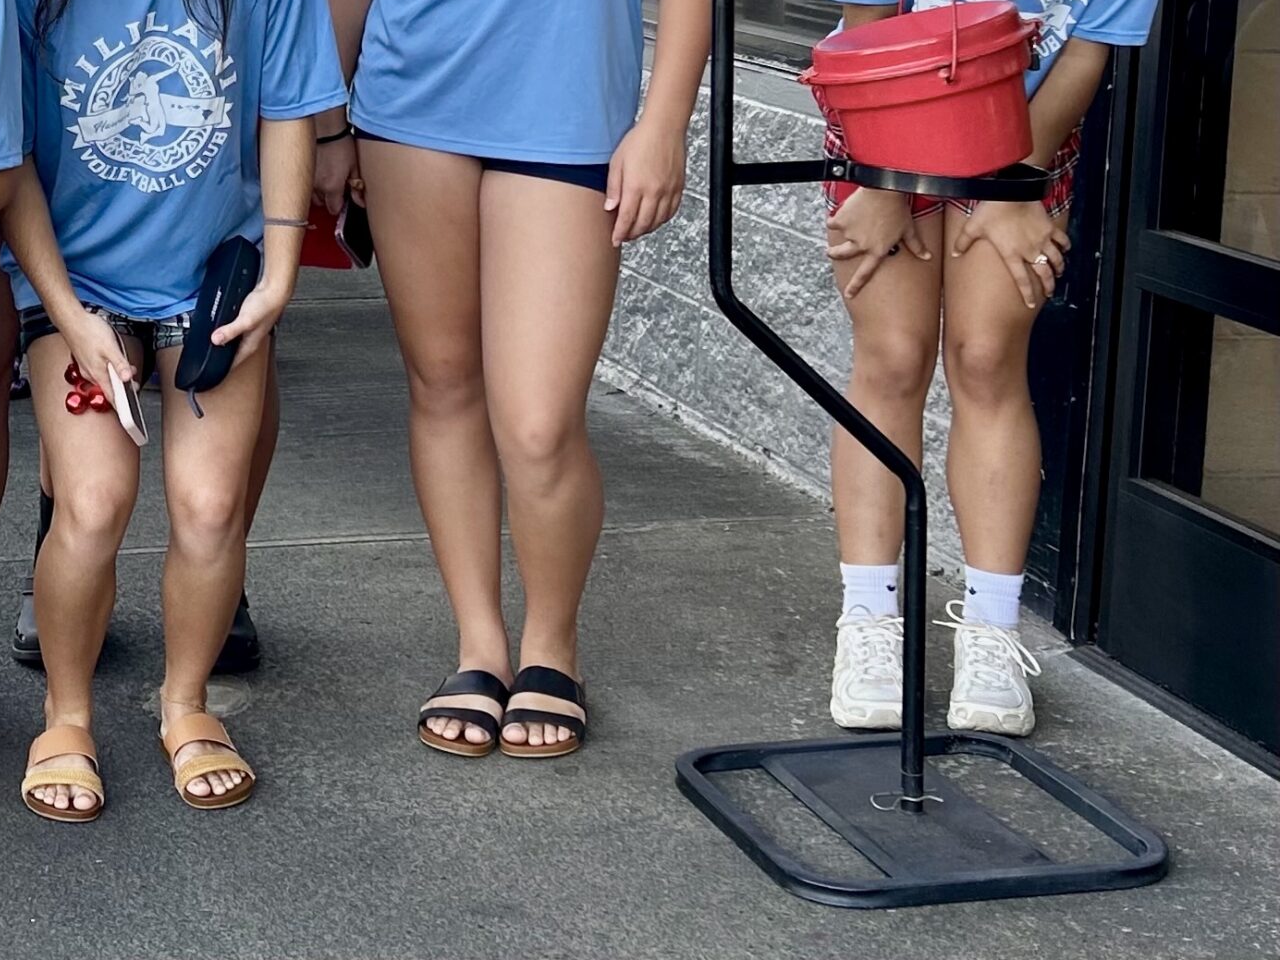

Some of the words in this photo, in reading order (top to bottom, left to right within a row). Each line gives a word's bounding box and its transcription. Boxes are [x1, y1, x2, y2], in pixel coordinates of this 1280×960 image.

[60, 11, 237, 112] MILILANI
[1036, 35, 1062, 58] UB
[80, 149, 185, 193] VOLLEYBALL
[185, 131, 228, 179] CLUB
